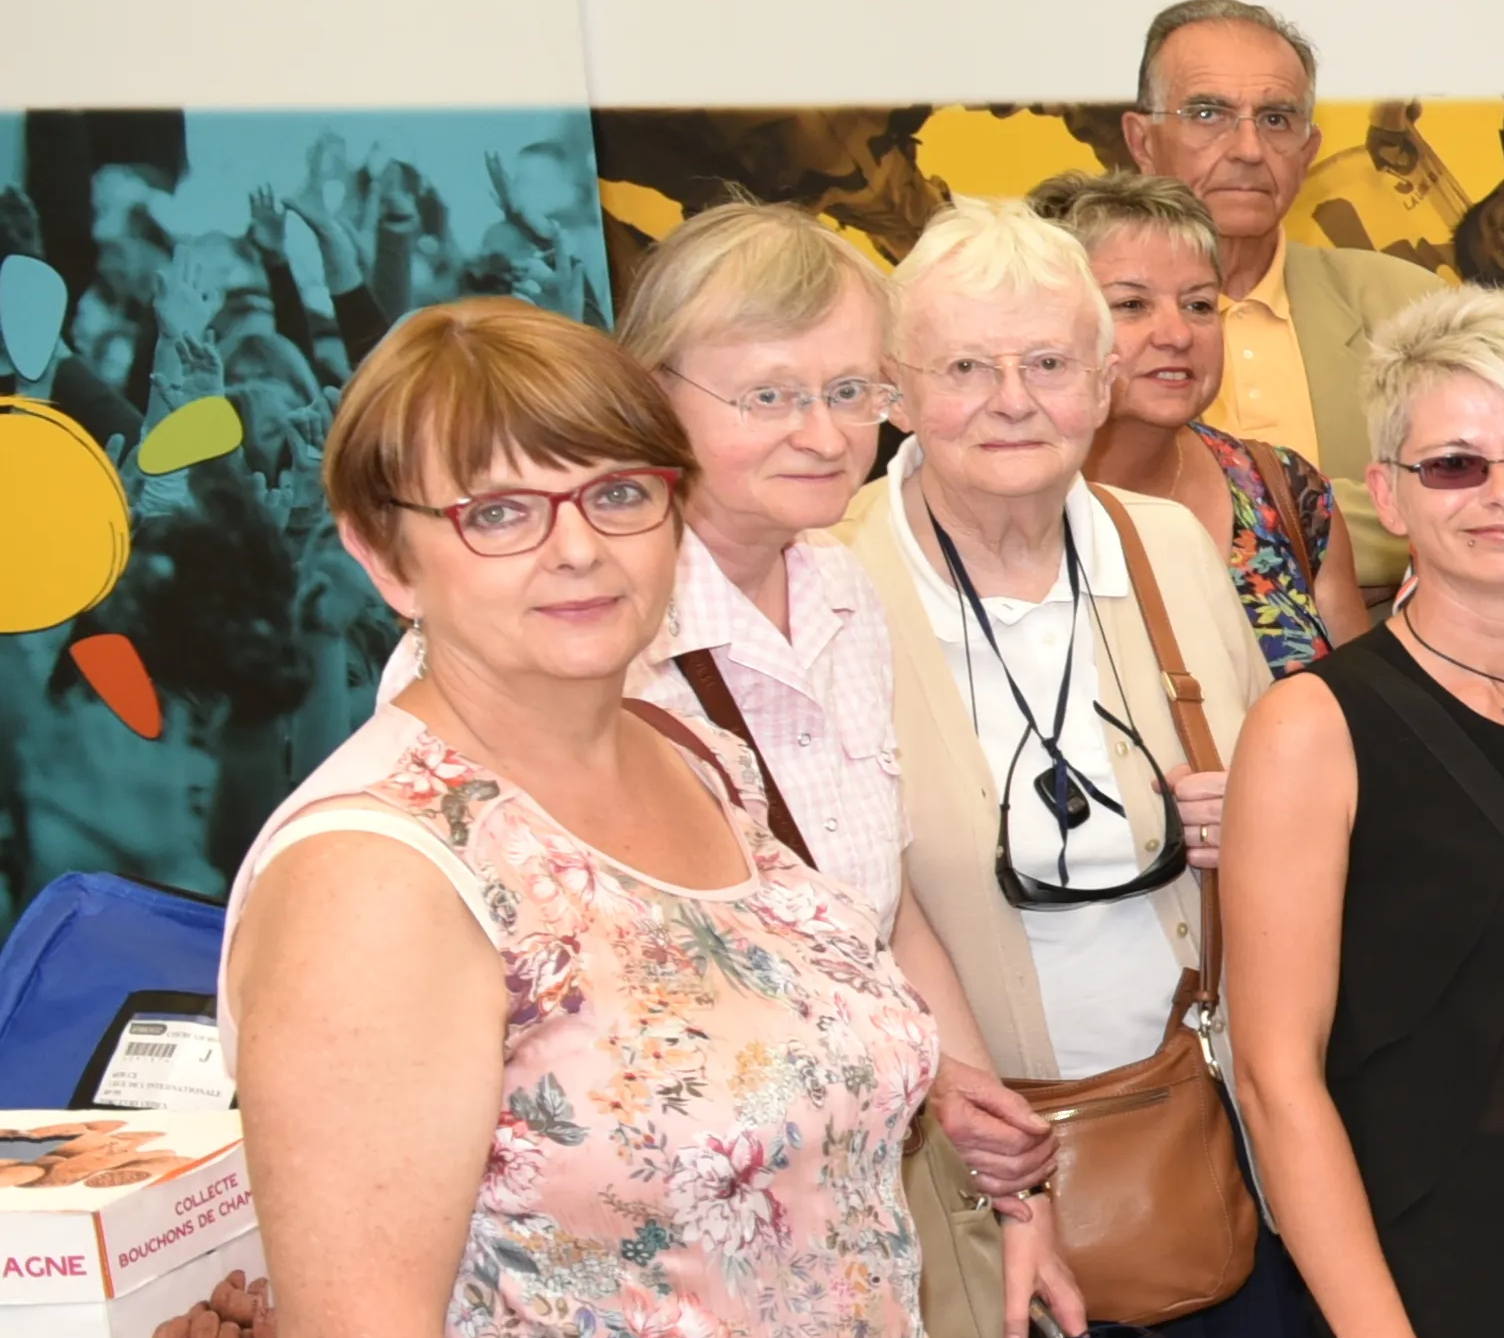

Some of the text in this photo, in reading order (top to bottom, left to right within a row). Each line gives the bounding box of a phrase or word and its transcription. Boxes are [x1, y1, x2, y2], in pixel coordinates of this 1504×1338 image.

[175, 1172, 239, 1216] COLLECTE
[118, 1219, 194, 1269] BOUCHONS
[198, 1209, 216, 1229] DE
[2, 1255, 88, 1278] AGNE
